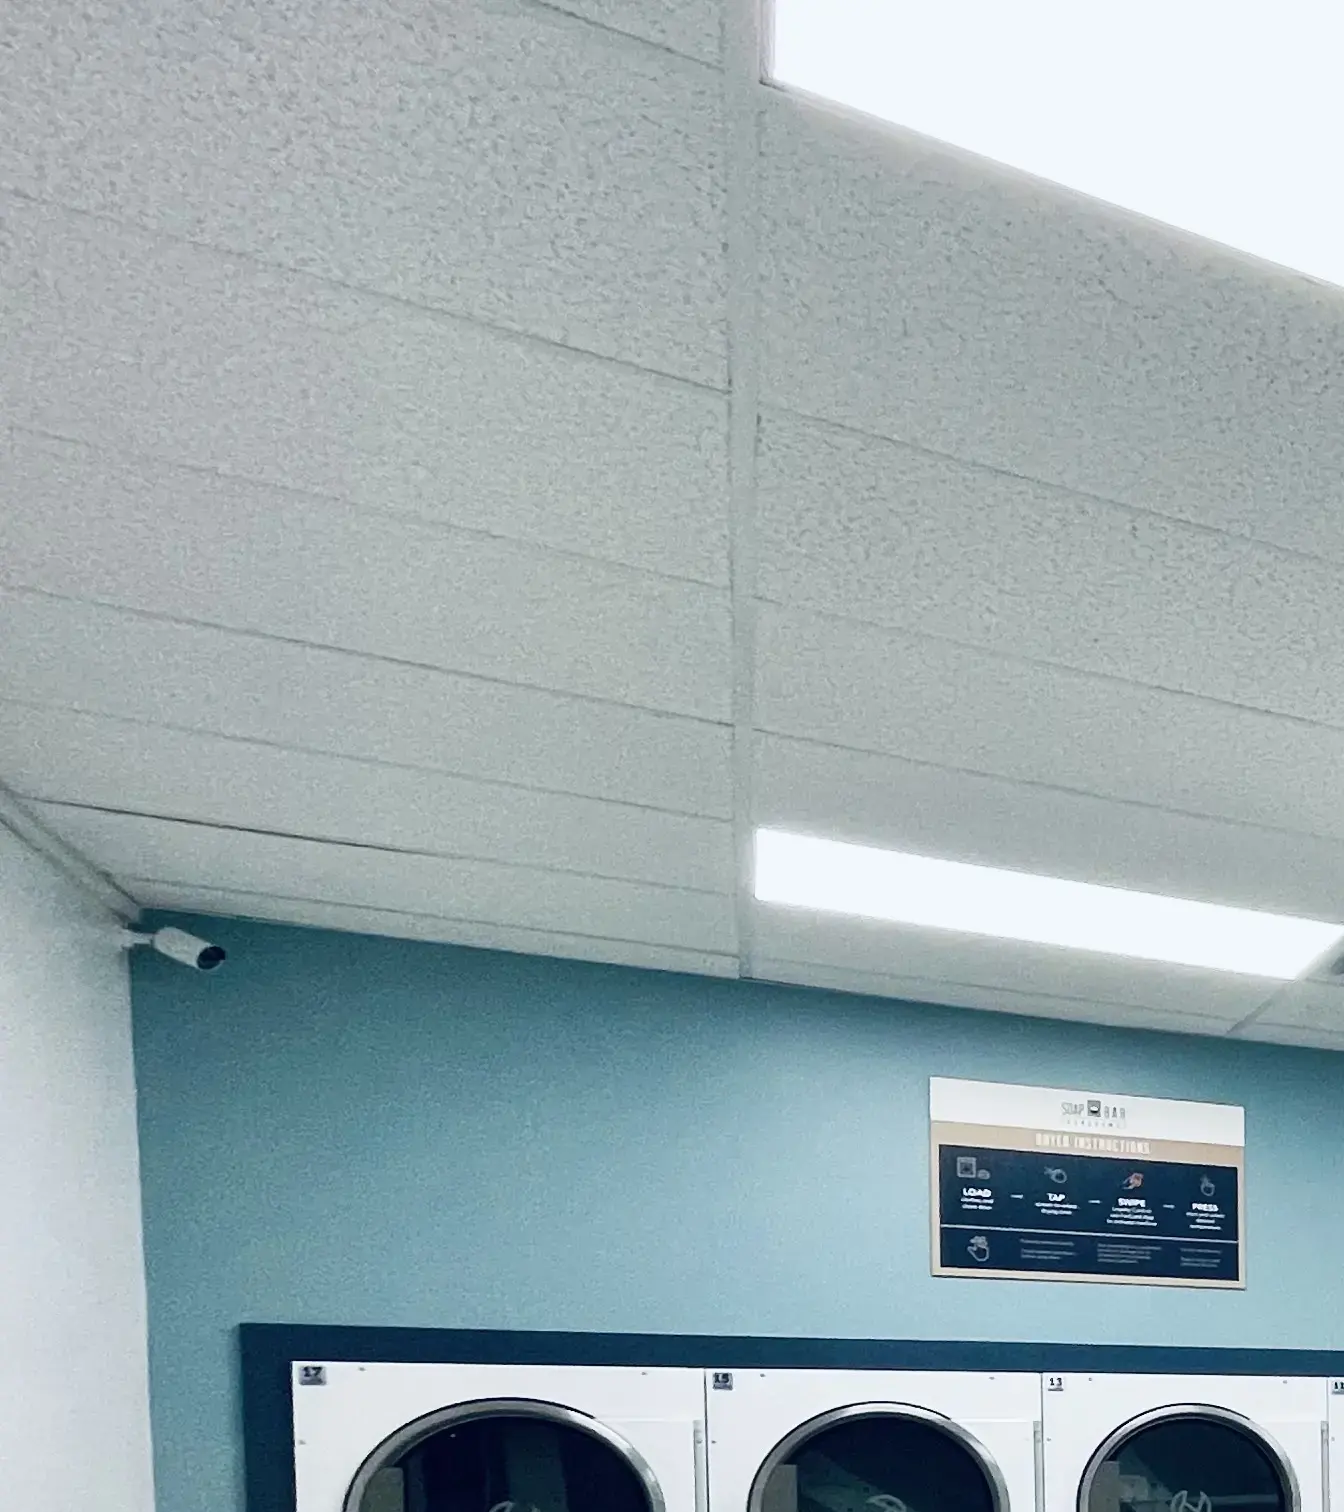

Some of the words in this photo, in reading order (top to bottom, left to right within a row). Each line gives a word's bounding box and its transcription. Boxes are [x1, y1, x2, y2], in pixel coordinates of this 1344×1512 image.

[1074, 1136, 1151, 1155] INSTRUCTIONS
[962, 1187, 992, 1198] LOAD
[1046, 1192, 1066, 1202] TAP
[303, 1365, 323, 1378] 17
[714, 1372, 730, 1383] 15
[1049, 1377, 1063, 1386] 13
